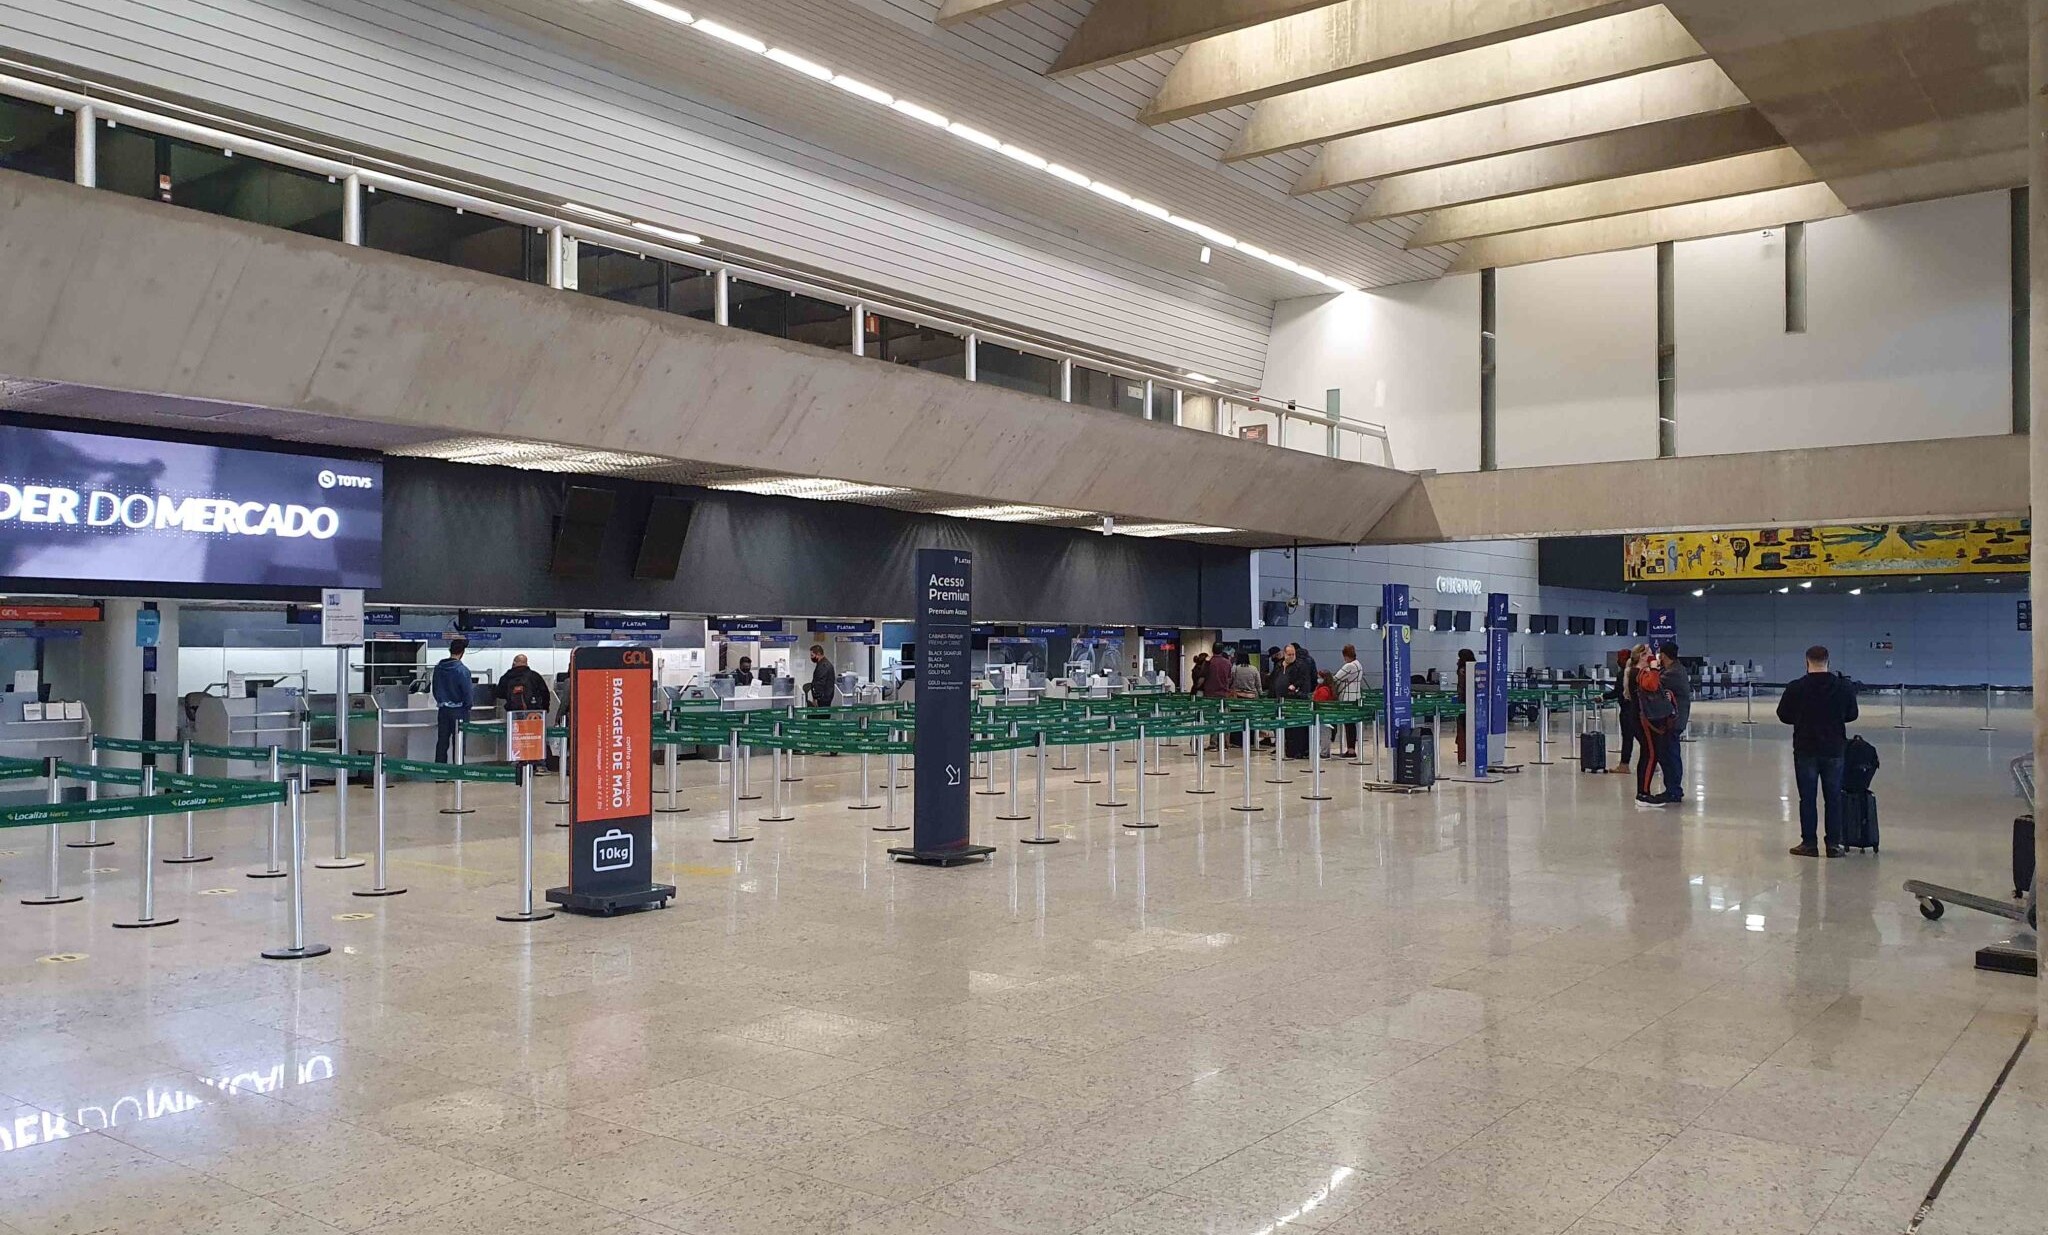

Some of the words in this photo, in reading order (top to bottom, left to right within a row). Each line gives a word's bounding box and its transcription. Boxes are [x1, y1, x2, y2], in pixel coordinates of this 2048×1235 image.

[337, 474, 372, 489] TOTVS
[929, 573, 964, 587] Acesso
[928, 607, 954, 615] Premium
[623, 651, 650, 664] GOL
[613, 678, 623, 747] BAGAGEM
[613, 752, 623, 770] DE
[613, 775, 626, 808] MÃO
[178, 798, 206, 806] Localiza
[14, 811, 48, 820] Localiza
[599, 846, 629, 861] 10kg
